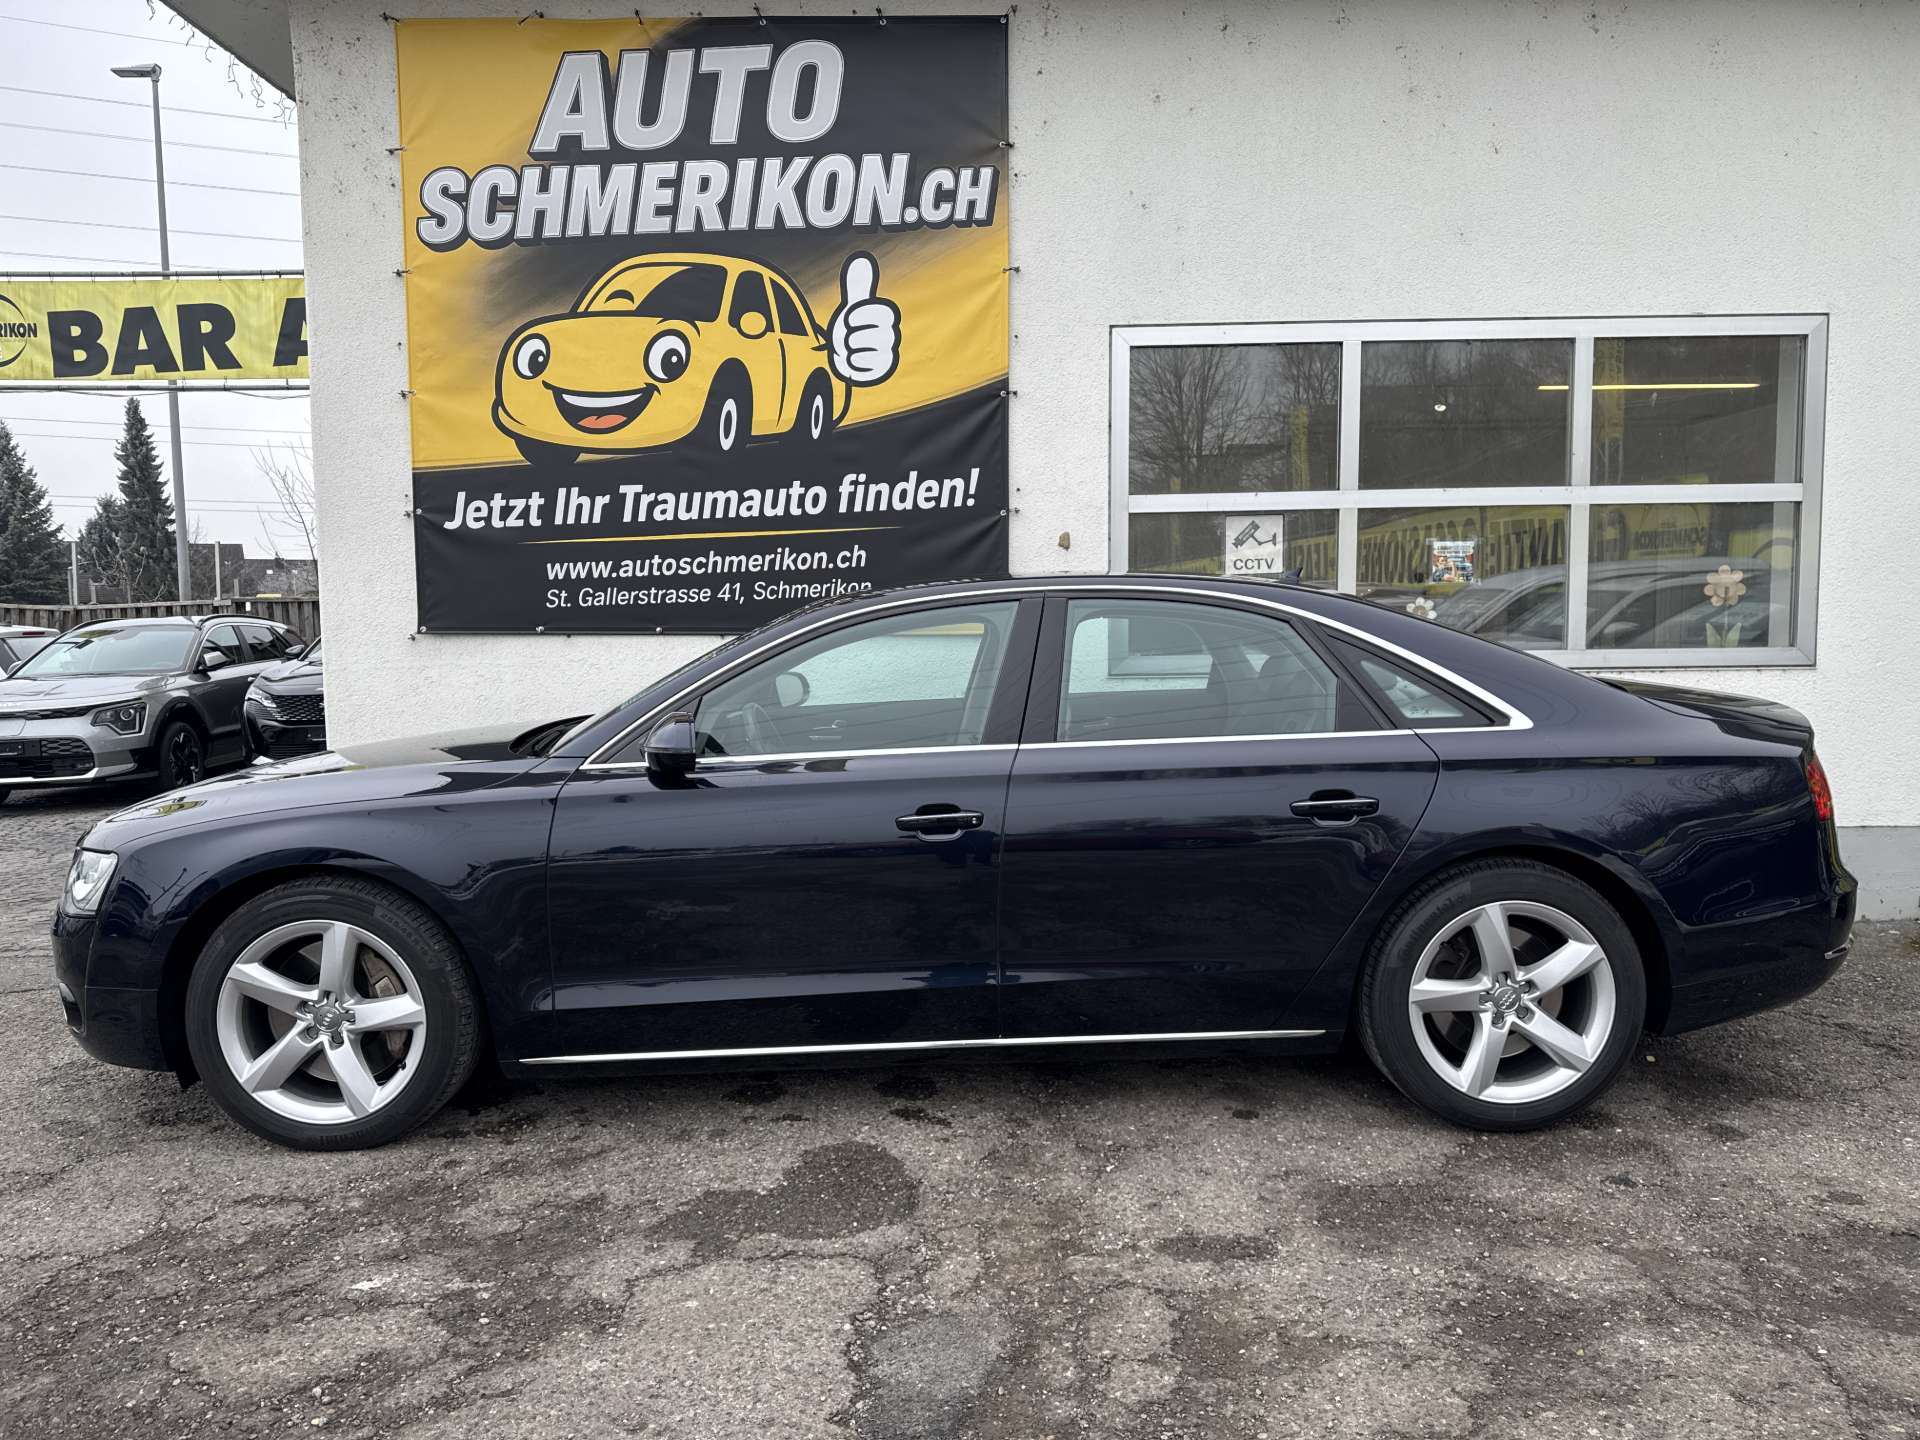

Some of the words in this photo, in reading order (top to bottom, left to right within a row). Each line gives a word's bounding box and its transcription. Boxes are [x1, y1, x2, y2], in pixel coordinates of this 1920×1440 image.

[528, 39, 846, 154] AUTO
[417, 153, 995, 245] SCHMERIKON.CH
[47, 302, 243, 378] BAR
[443, 490, 544, 530] Jetzt
[553, 487, 610, 526] Ihr
[619, 480, 828, 524] Traumauto
[839, 467, 980, 514] finden!
[546, 544, 867, 580] www.autoschmerikon.ch
[546, 588, 572, 608] St.
[578, 585, 711, 608] Gallerstrasse
[717, 582, 745, 605] 41,
[753, 579, 872, 601] Schmerikon
[1233, 557, 1275, 571] CCTV
